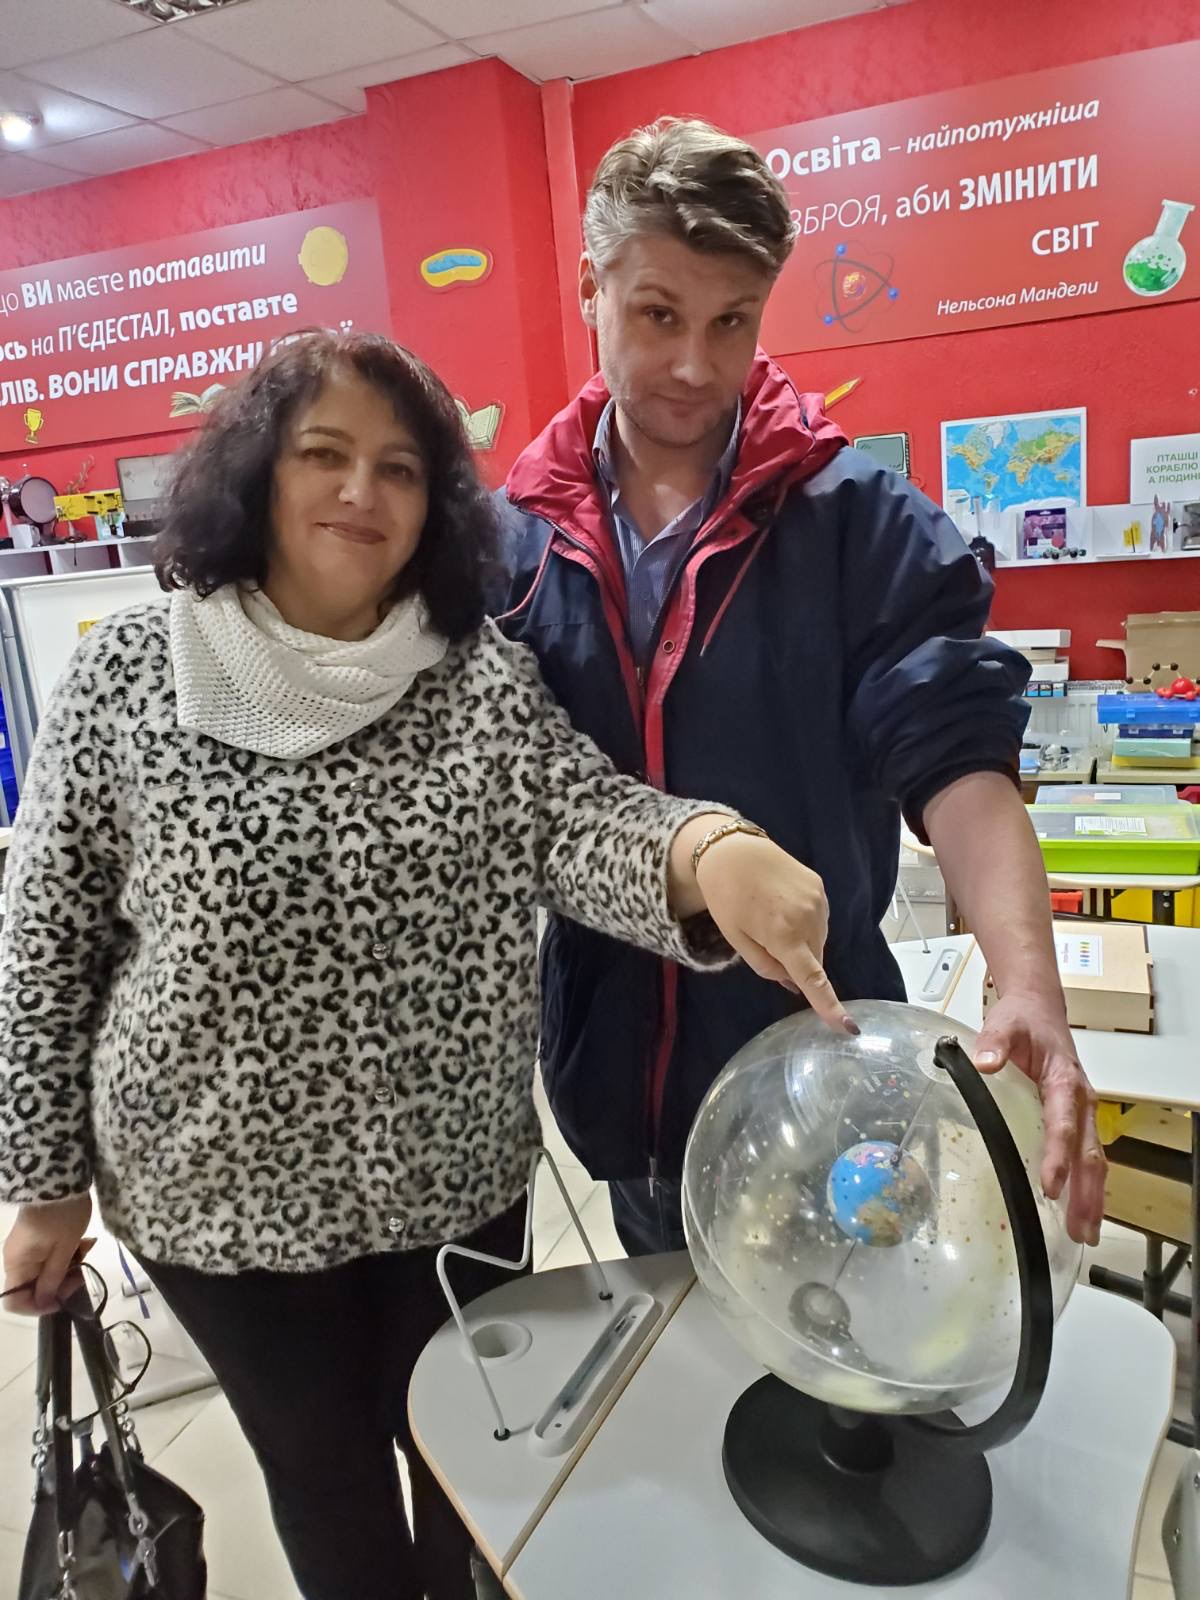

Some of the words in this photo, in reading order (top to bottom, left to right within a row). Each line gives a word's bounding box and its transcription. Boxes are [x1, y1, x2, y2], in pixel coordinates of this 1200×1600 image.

[766, 135, 881, 180] Освіта
[906, 99, 1100, 154] найпотужніша
[895, 184, 951, 219] аби
[959, 154, 1098, 211] ЗМІНИТИ
[1031, 220, 1100, 256] СВІТ
[21, 279, 53, 309] ВИ
[56, 272, 124, 302] маєте
[128, 243, 266, 289] поставити
[936, 293, 1016, 316] Нельсона
[1019, 281, 1099, 306] Мандели
[31, 335, 54, 357] на
[179, 292, 298, 332] поставте
[48, 365, 118, 400] ВОНИ
[123, 340, 264, 388] СПРАВЖНІ
[1146, 462, 1199, 473] КОРАБЛЮ
[1157, 451, 1198, 462] ПТАШЦІ
